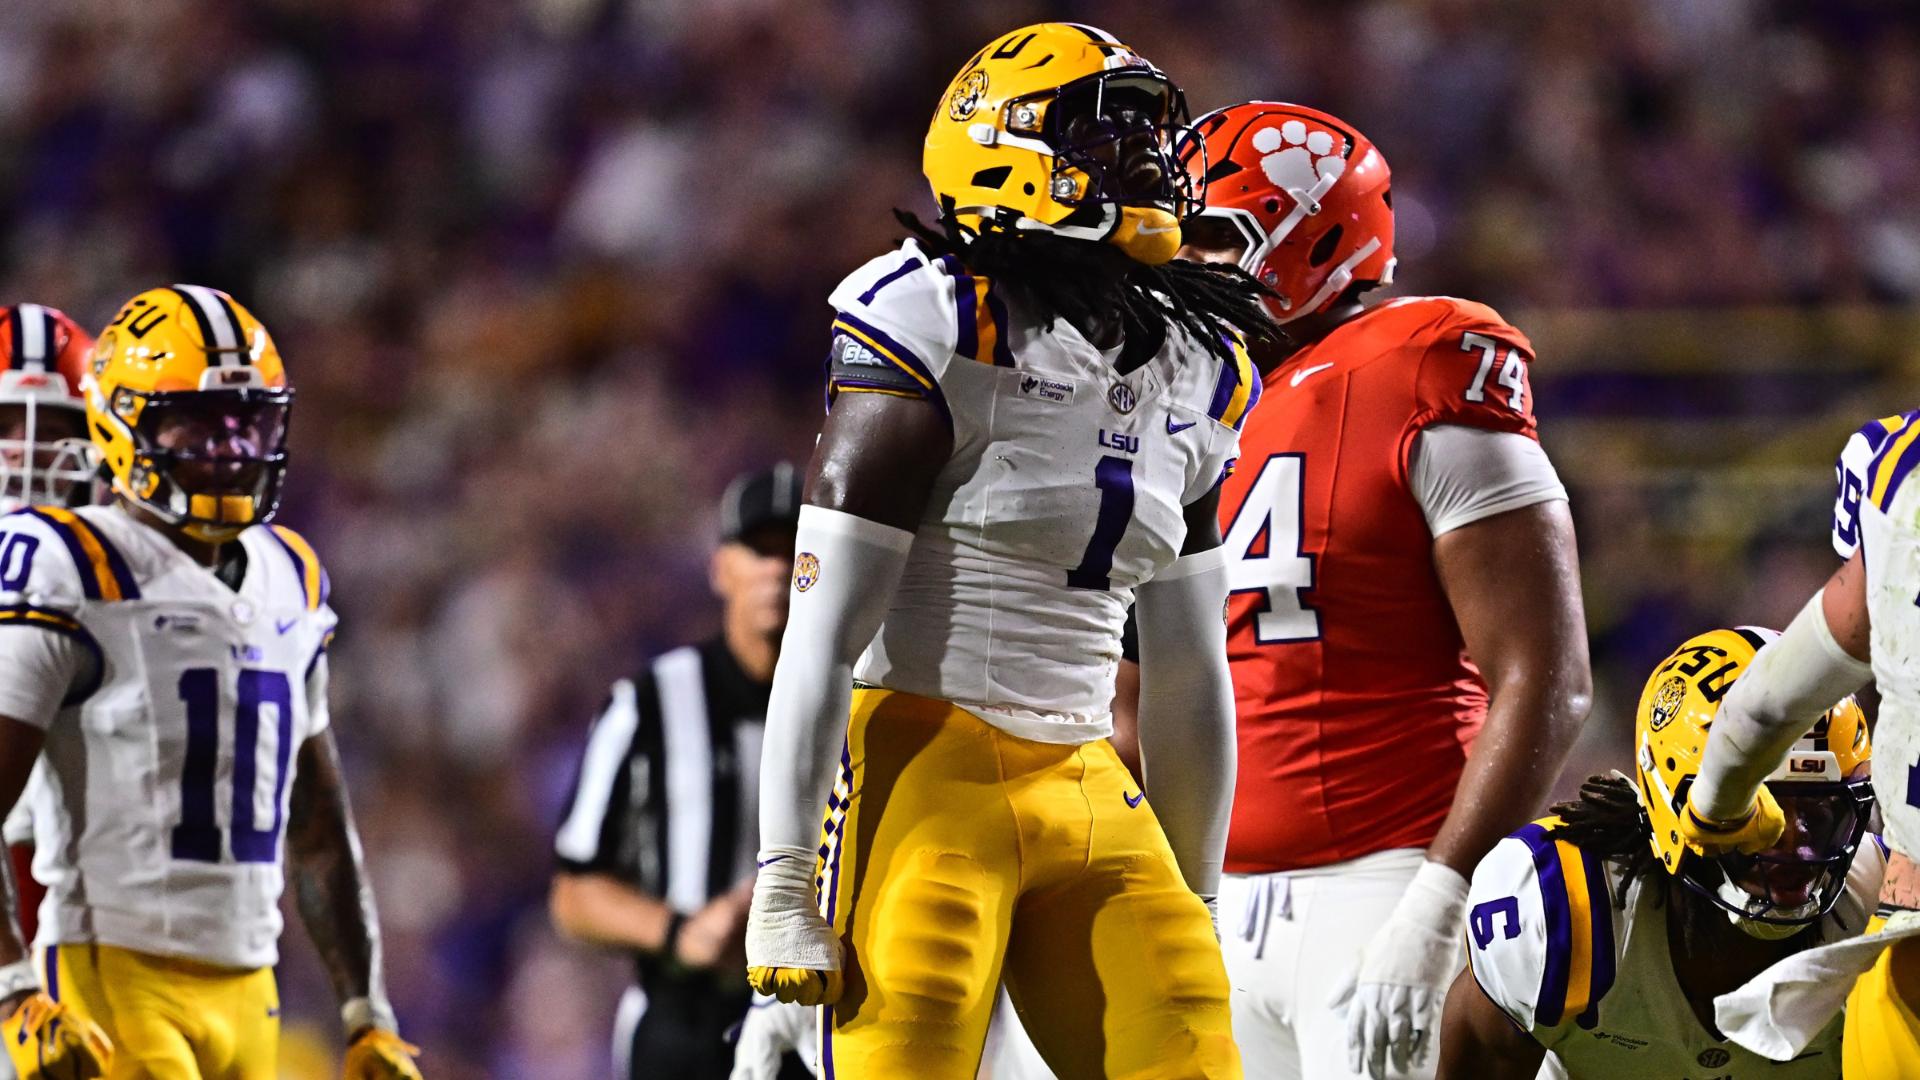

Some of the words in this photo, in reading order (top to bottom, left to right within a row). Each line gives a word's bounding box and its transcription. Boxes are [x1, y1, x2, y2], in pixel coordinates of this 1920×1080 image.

[857, 257, 923, 307] 1
[1040, 387, 1065, 402] Energy
[1460, 330, 1527, 414] 74
[1099, 428, 1139, 454] LSU
[1067, 455, 1135, 591] 1
[0, 531, 40, 592] 0
[171, 668, 292, 863] 10
[1790, 758, 1826, 773] LSU
